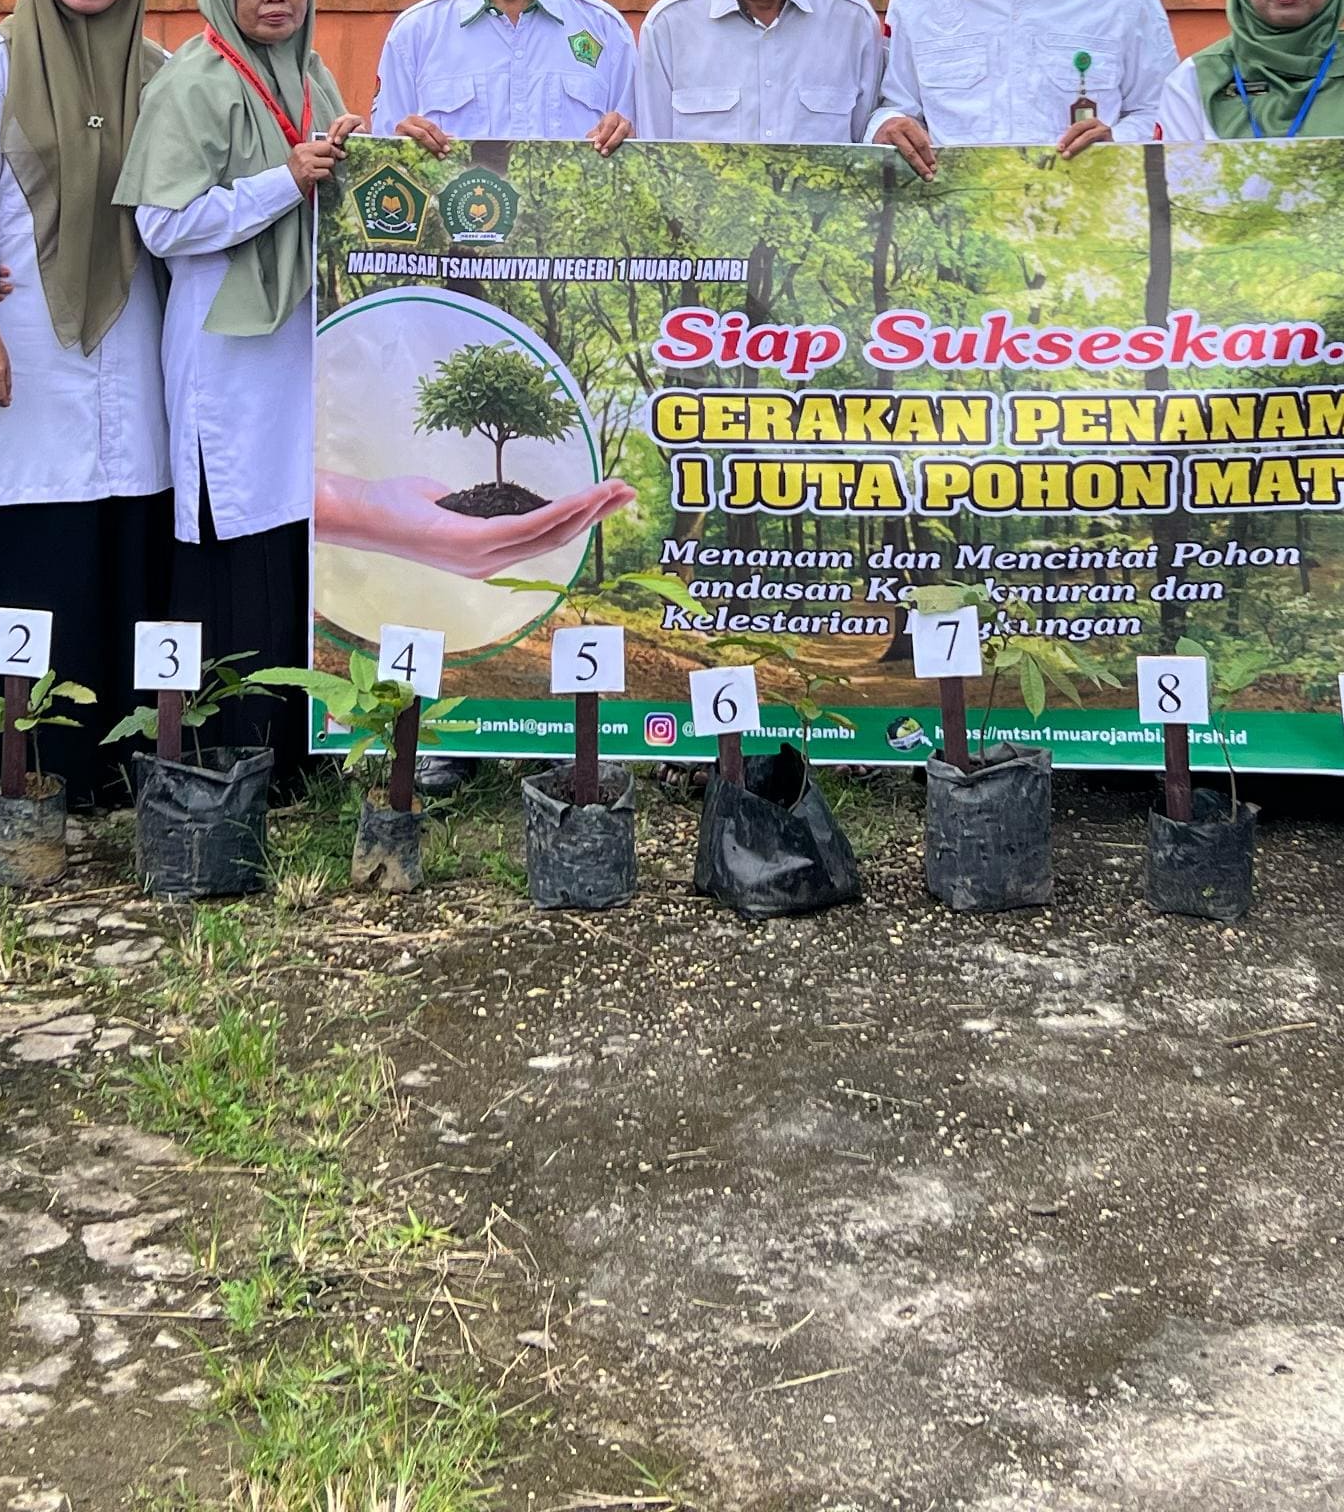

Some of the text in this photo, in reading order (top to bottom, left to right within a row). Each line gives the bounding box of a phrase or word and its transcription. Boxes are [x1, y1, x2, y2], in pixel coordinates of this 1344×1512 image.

[347, 251, 749, 281] MADRASAH TSANAWIYAH NEGERI 1 MUARO JAMBI
[658, 311, 842, 375] Siap
[656, 392, 989, 445] GERAKAN
[678, 460, 710, 508] 1
[731, 460, 904, 509] JUTA
[923, 460, 1169, 509] POHON
[659, 539, 1301, 570] Menanam dan Mencintai Pohon
[660, 572, 1224, 603] andasan Kekmuran dan
[661, 604, 889, 634] Kelestarian
[5, 623, 33, 665] 2
[157, 638, 181, 679] 3
[391, 642, 417, 681] 4
[575, 641, 599, 681] 5
[936, 620, 961, 662] 7
[711, 683, 739, 724] 6
[1157, 673, 1183, 716] 8
